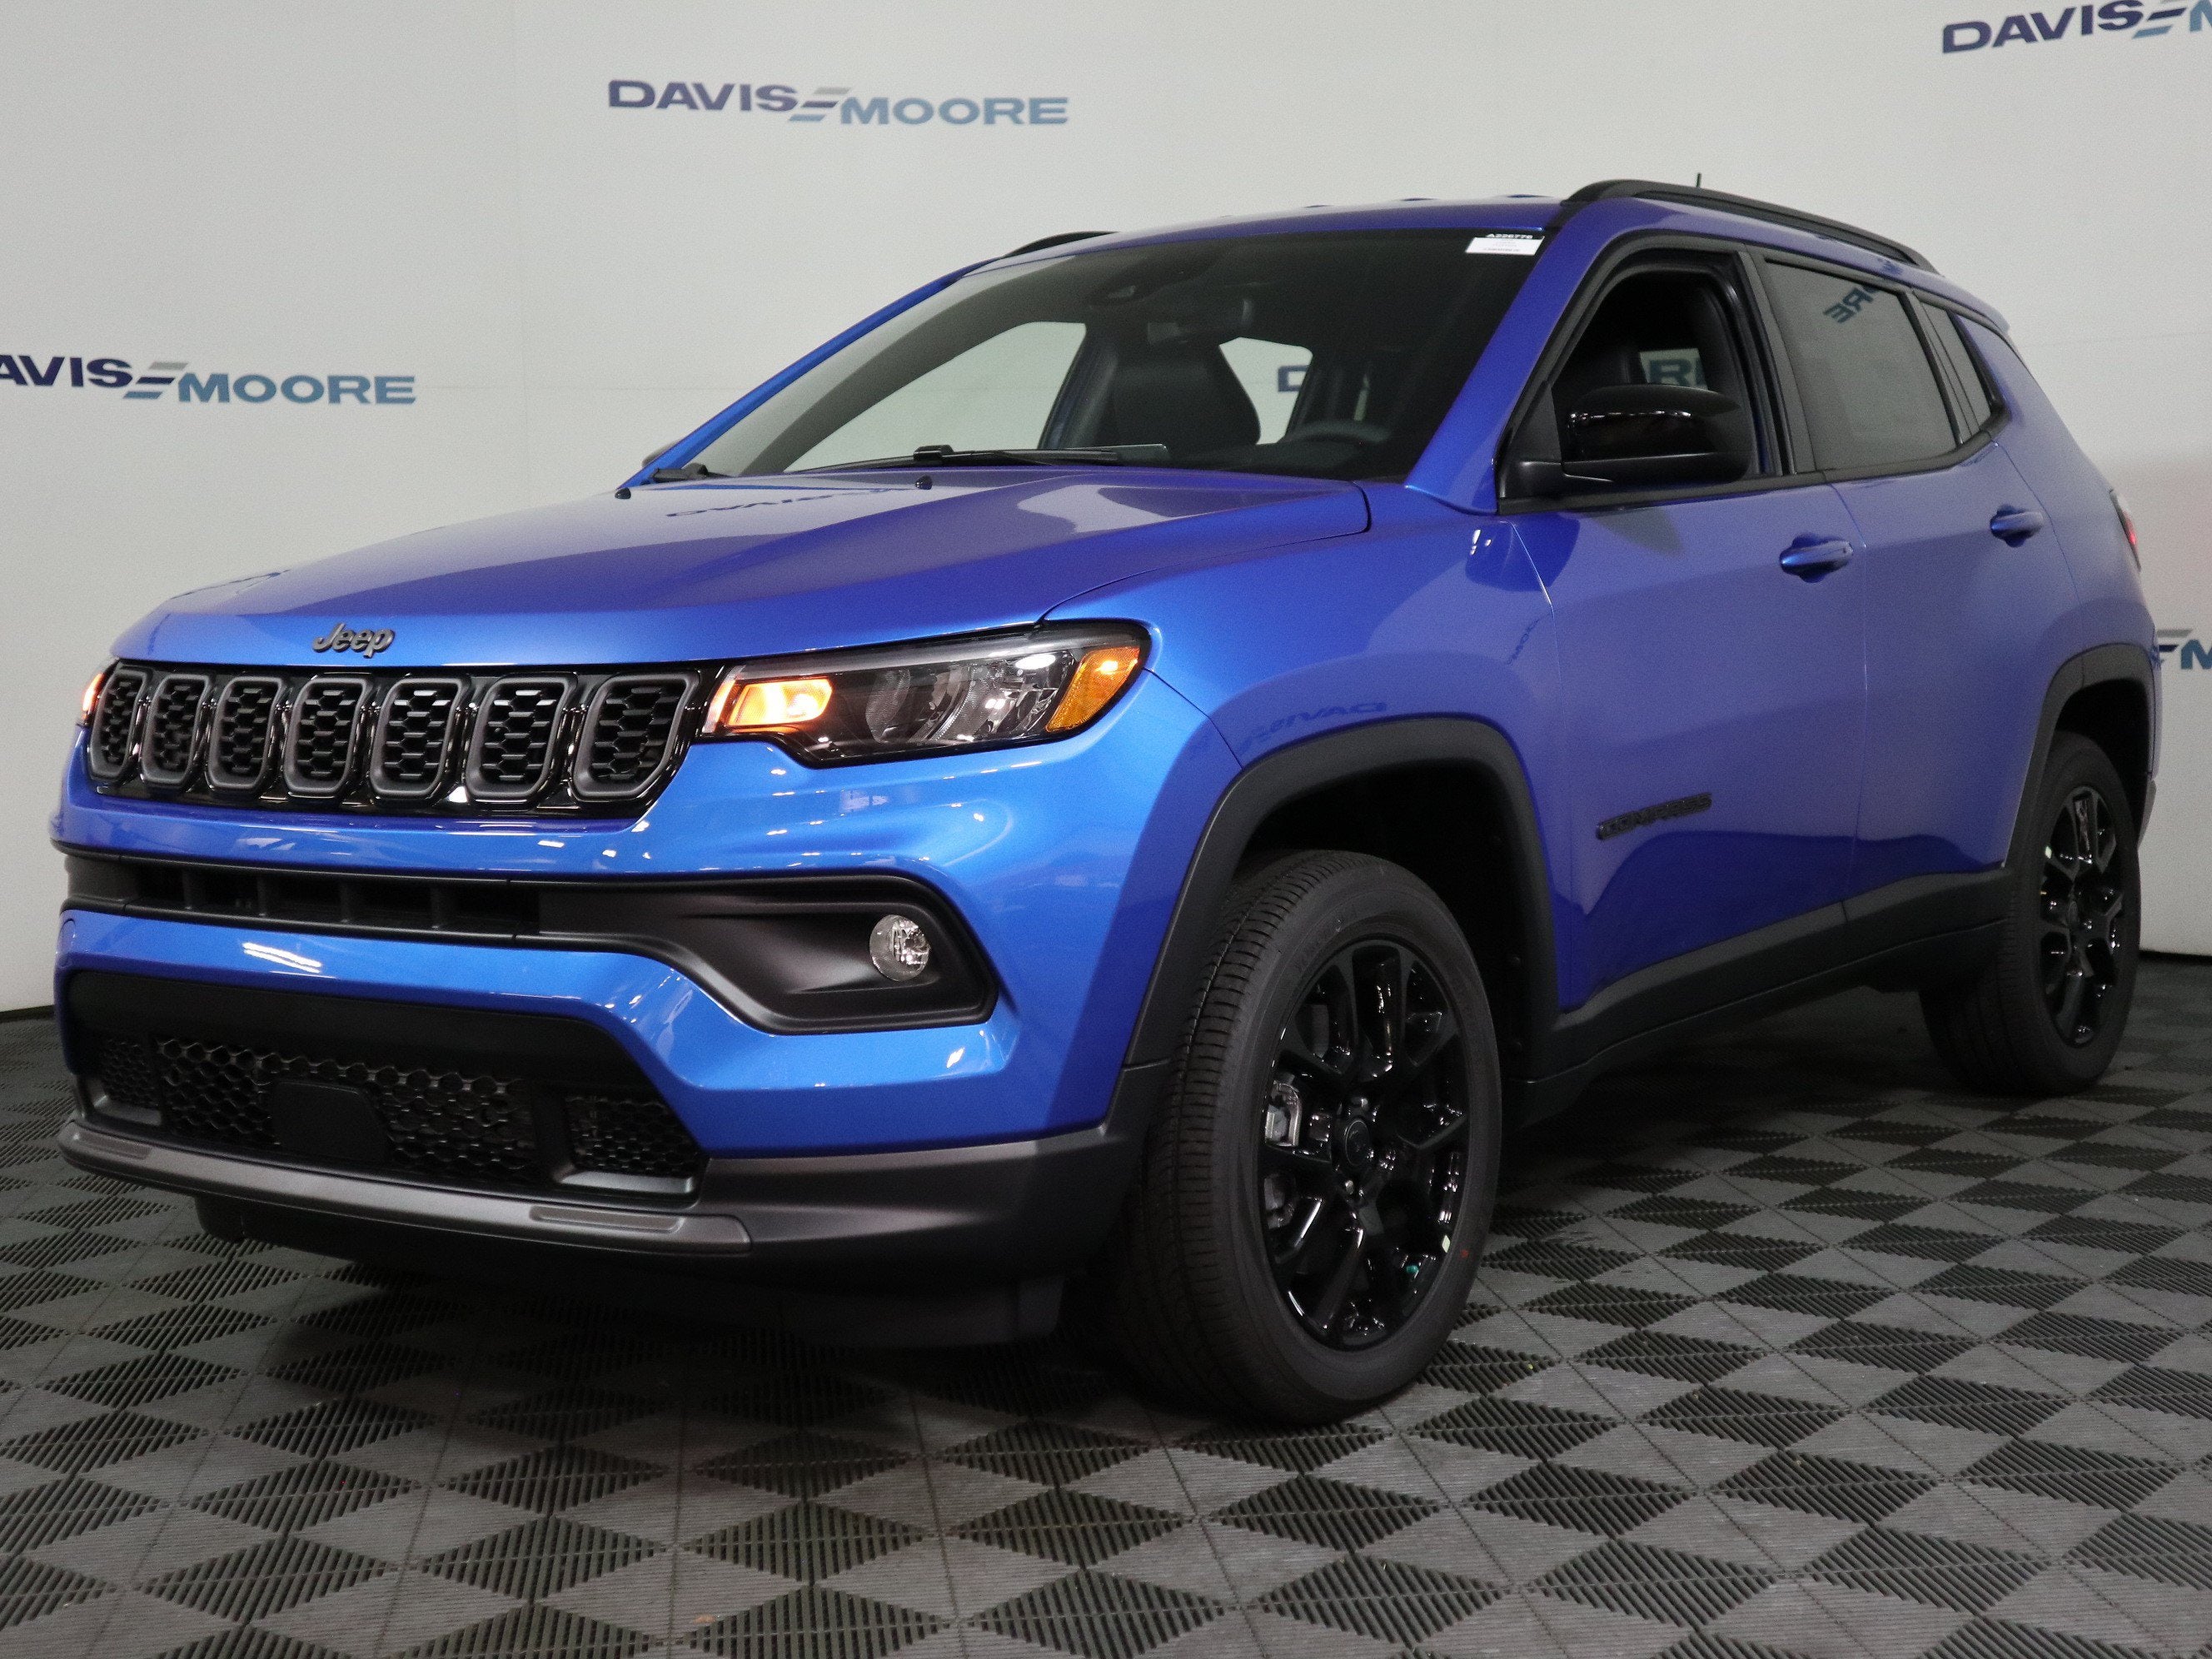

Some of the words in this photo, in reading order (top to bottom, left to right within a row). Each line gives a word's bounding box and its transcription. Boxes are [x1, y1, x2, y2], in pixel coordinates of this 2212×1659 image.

[1942, 0, 2144, 54] DAVIS
[608, 80, 798, 112] DAVIS
[840, 97, 1069, 126] MOORE
[177, 372, 416, 405] MOORE
[312, 623, 396, 659] Jeep
